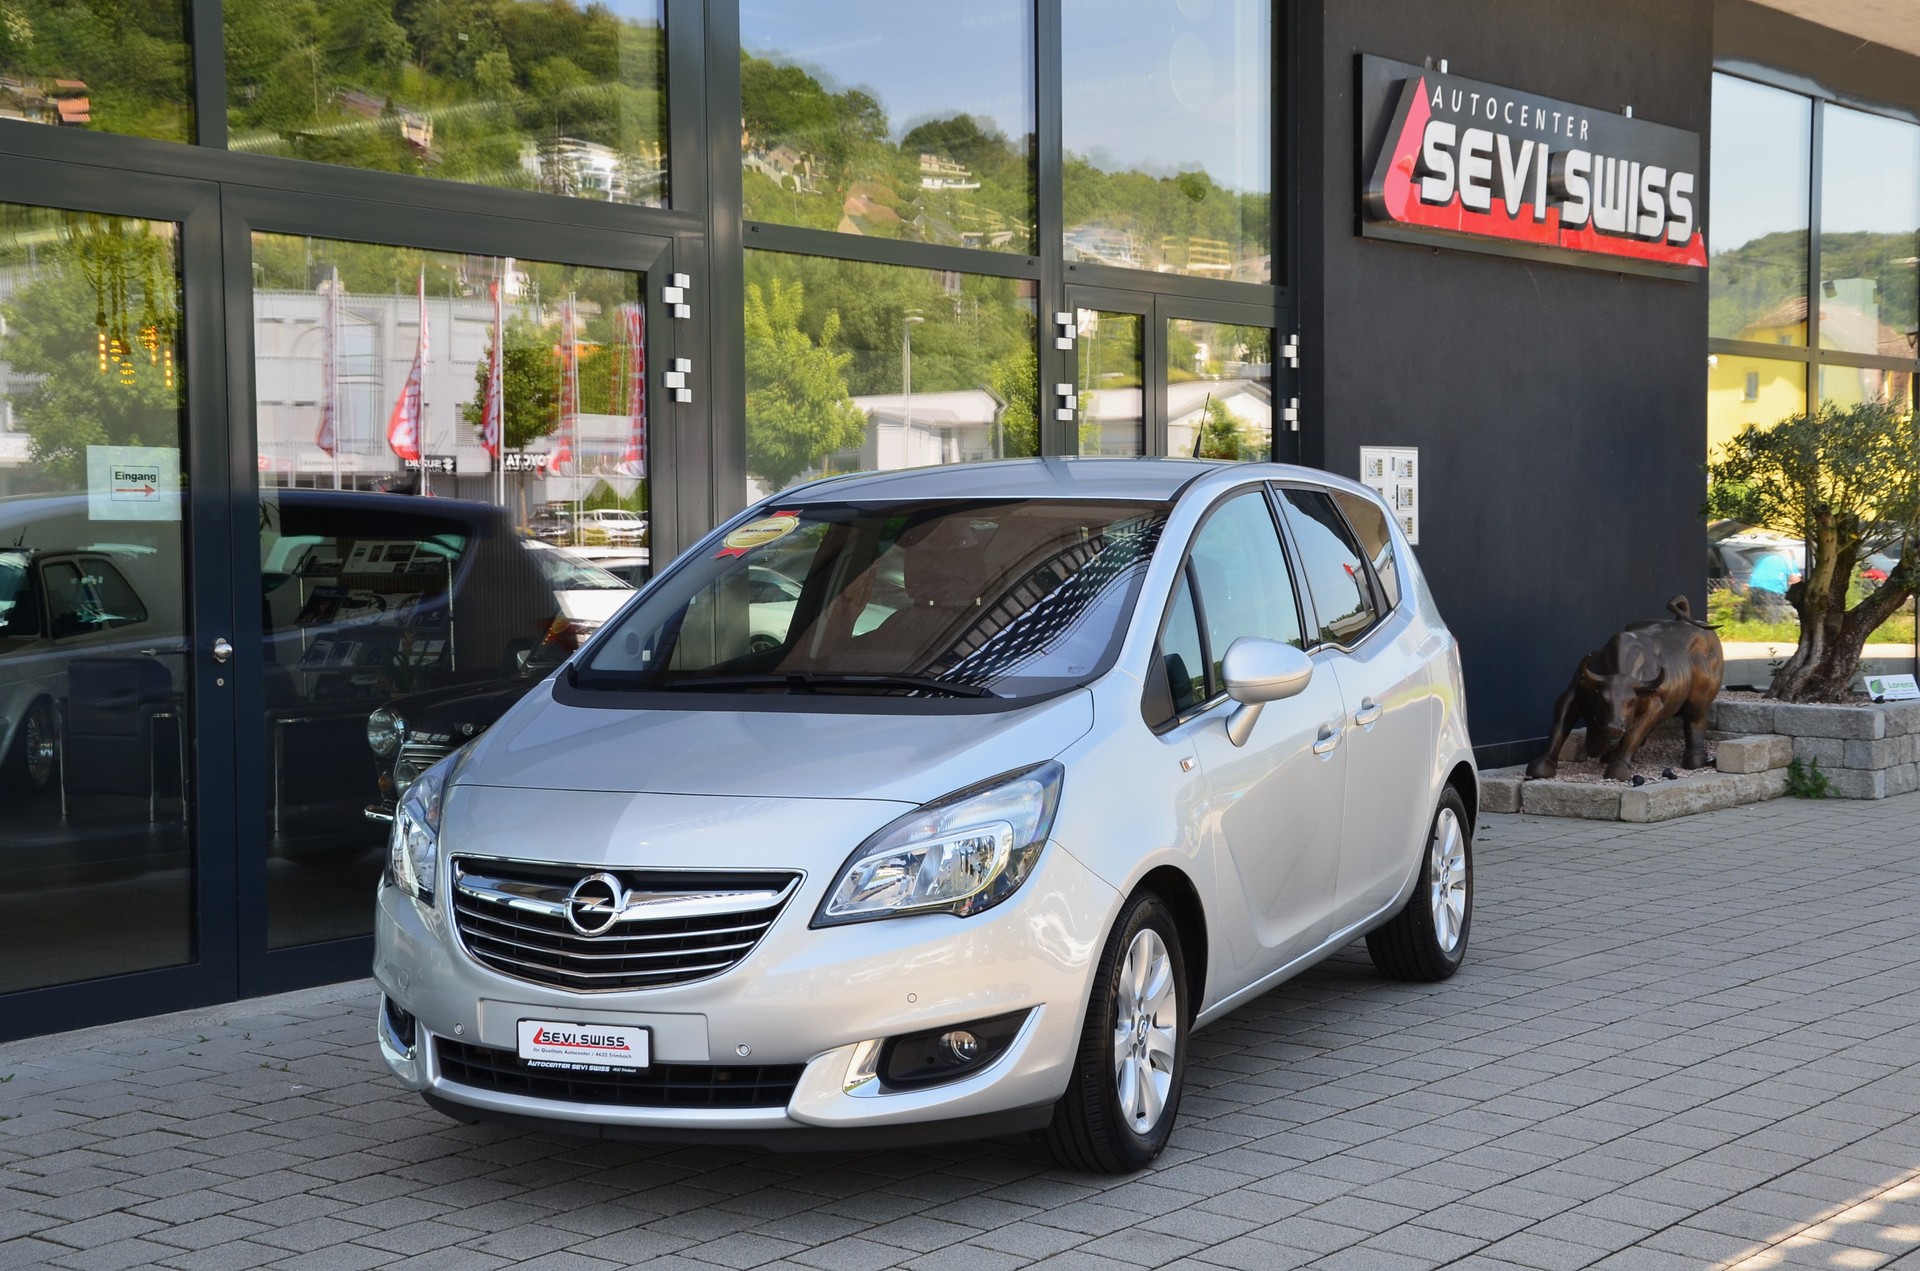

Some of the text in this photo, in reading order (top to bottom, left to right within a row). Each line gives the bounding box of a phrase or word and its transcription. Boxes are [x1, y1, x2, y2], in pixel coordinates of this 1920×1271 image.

[1431, 85, 1588, 140] AUTOCENTER
[1421, 120, 1694, 242] SEVI SWISS
[115, 471, 156, 482] Eingang
[542, 1032, 625, 1047] SEVI SWISS
